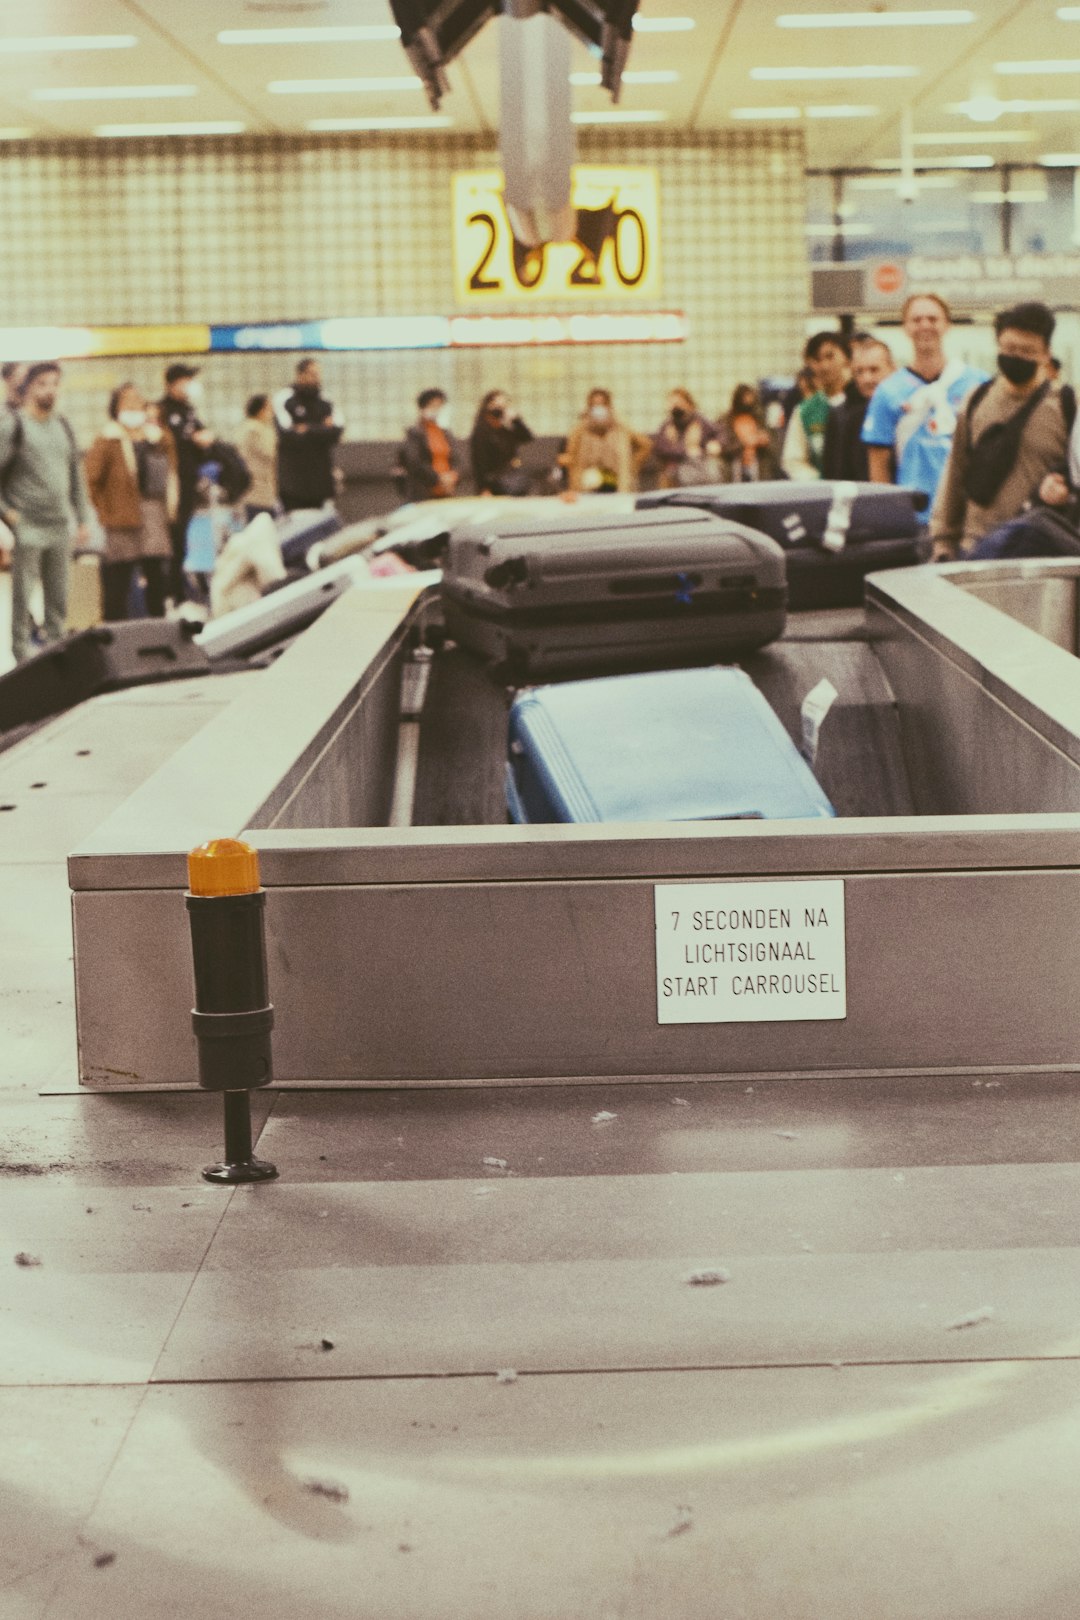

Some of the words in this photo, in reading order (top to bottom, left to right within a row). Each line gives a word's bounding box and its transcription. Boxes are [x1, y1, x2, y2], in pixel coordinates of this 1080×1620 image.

[671, 911, 680, 931] 7
[692, 908, 791, 931] SECONDEN
[804, 907, 829, 928] NA
[685, 941, 816, 964] LICHTSIGNAAL
[662, 975, 718, 997] START
[731, 973, 840, 996] CARROUSEL
